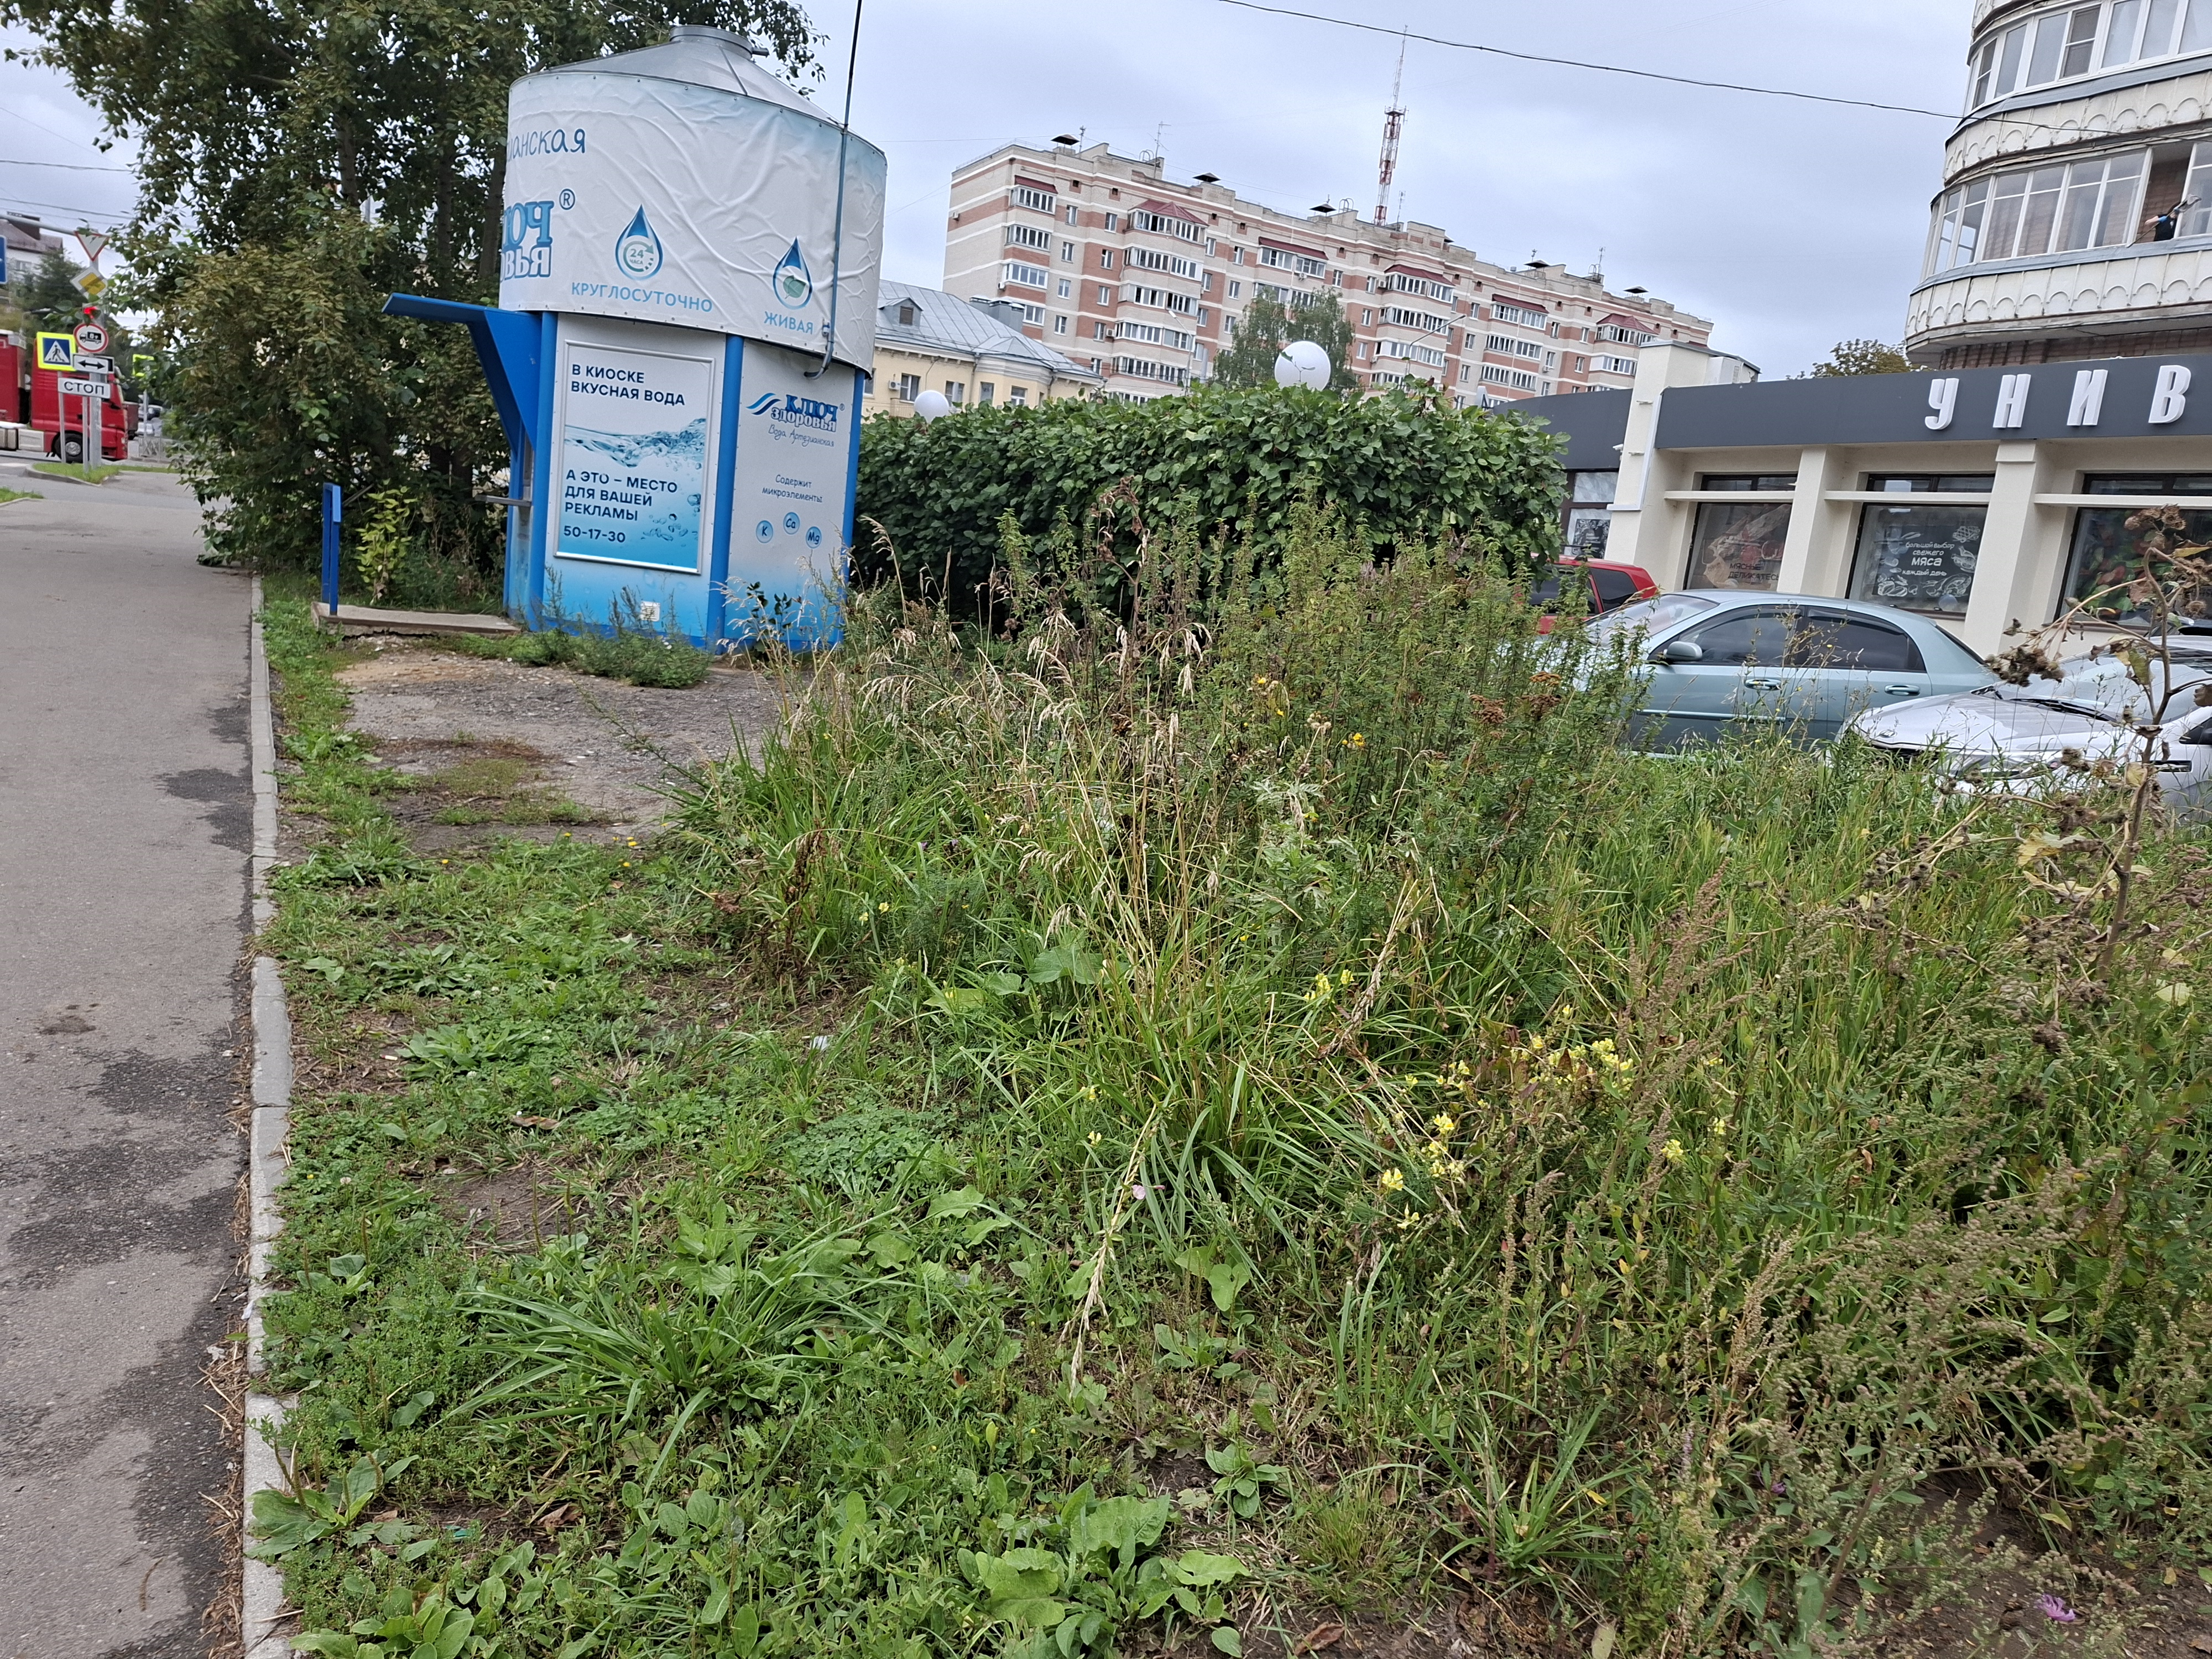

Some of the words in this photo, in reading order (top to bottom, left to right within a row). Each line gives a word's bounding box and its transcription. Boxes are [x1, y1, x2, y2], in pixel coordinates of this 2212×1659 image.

[630, 248, 644, 258] 24
[572, 282, 713, 312] КРУГЛОСУТОЧНО
[764, 311, 813, 335] ЖИВАЯ
[572, 364, 581, 375] В
[586, 366, 645, 384] КИОСКЕ
[64, 381, 104, 395] СТОП
[571, 381, 639, 400] ВКУСНАЯ
[644, 390, 685, 406] ВОДА
[1924, 364, 2192, 430] УНИВ
[785, 394, 838, 422] КЛЮЧ
[768, 424, 786, 440] Вода
[789, 429, 834, 447] Артезианская
[566, 469, 576, 481] А
[581, 471, 609, 484] ЭТО
[627, 477, 677, 493] МЕСТО
[775, 474, 812, 488] Содержит
[565, 486, 595, 499] ДЛЯ
[600, 490, 652, 507] ВАШЕЙ
[762, 487, 823, 503] микроэлементы
[565, 502, 638, 521] РЕКЛАМЫ
[786, 518, 796, 529] Ca
[564, 525, 625, 543] 50-17-30
[807, 532, 820, 545] Mg
